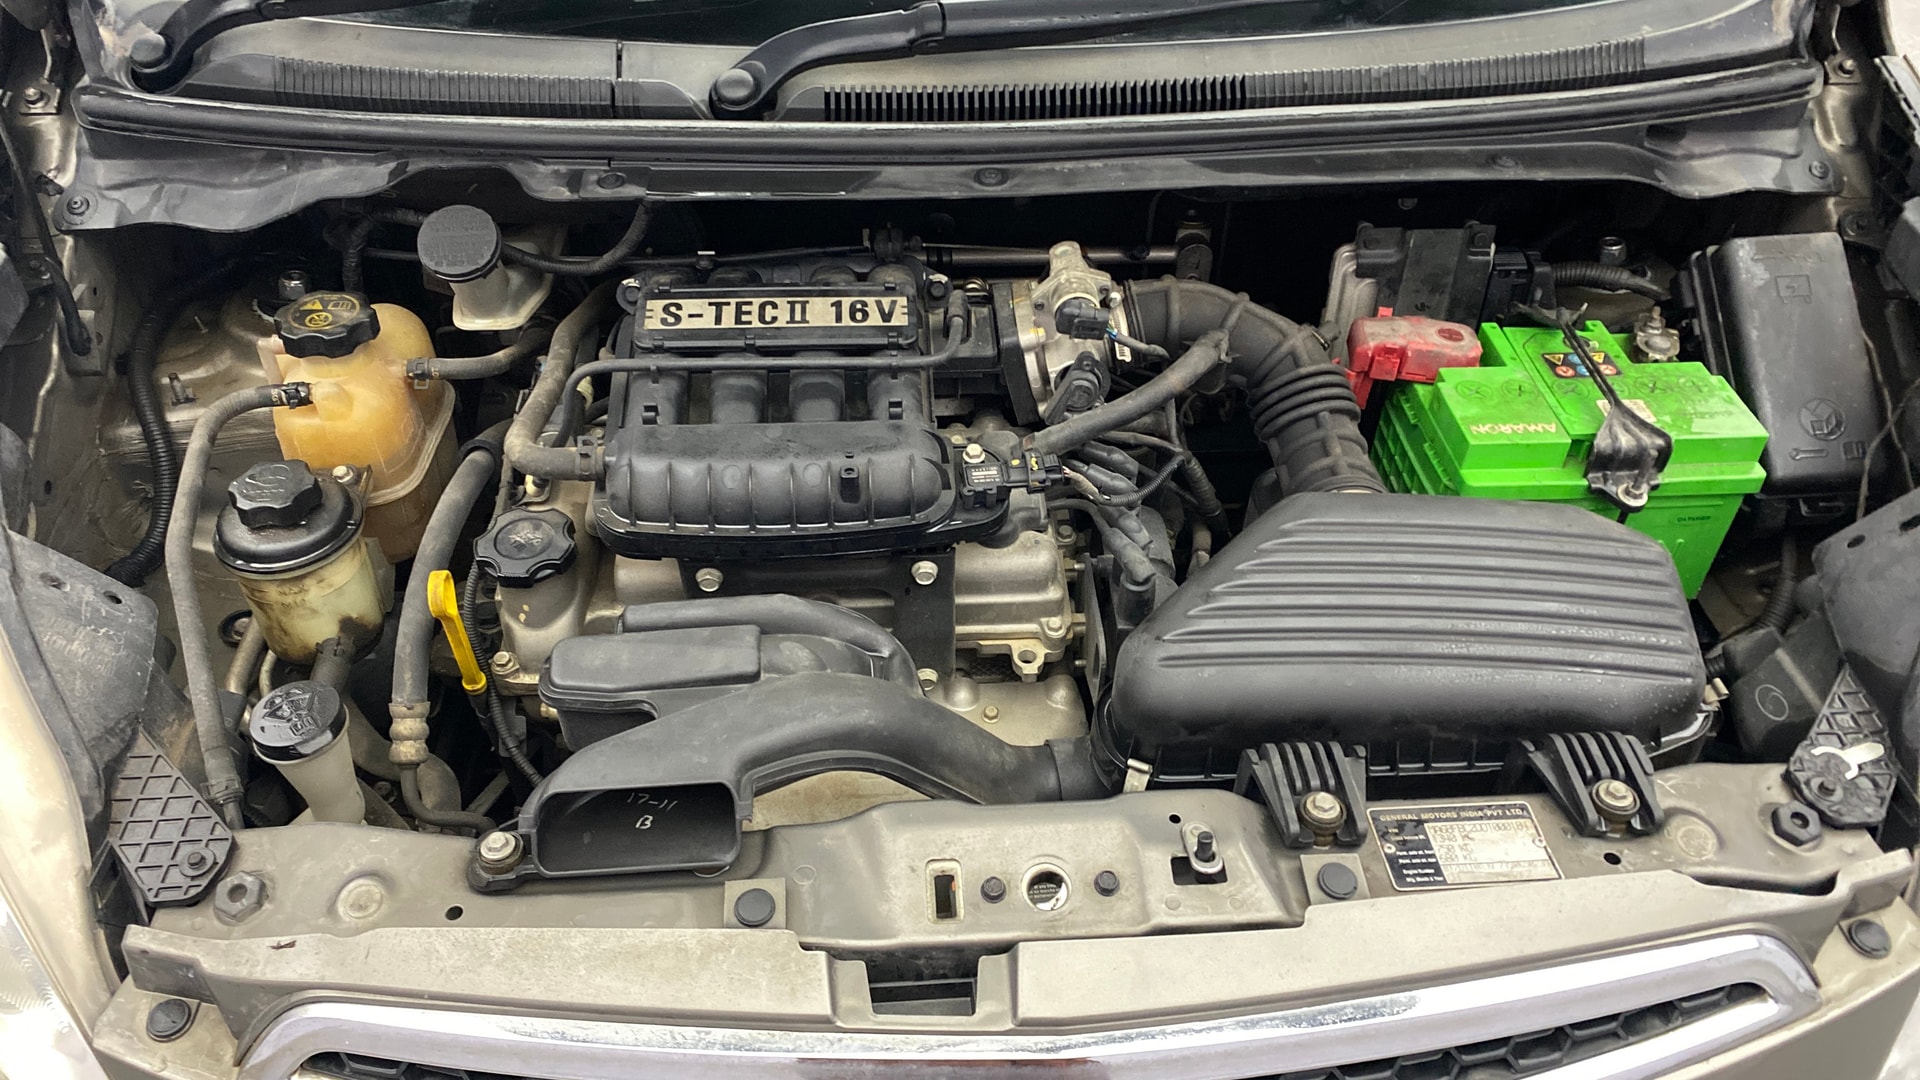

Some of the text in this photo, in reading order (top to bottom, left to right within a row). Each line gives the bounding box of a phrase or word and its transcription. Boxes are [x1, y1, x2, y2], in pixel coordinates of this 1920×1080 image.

[830, 299, 898, 325] 16V
[1469, 423, 1557, 434] AMARON
[635, 814, 653, 829] B
[1380, 813, 1418, 822] GENERAL
[1421, 811, 1458, 820] MOTORS
[1460, 810, 1484, 819] INDIA
[1487, 809, 1503, 817] PVT
